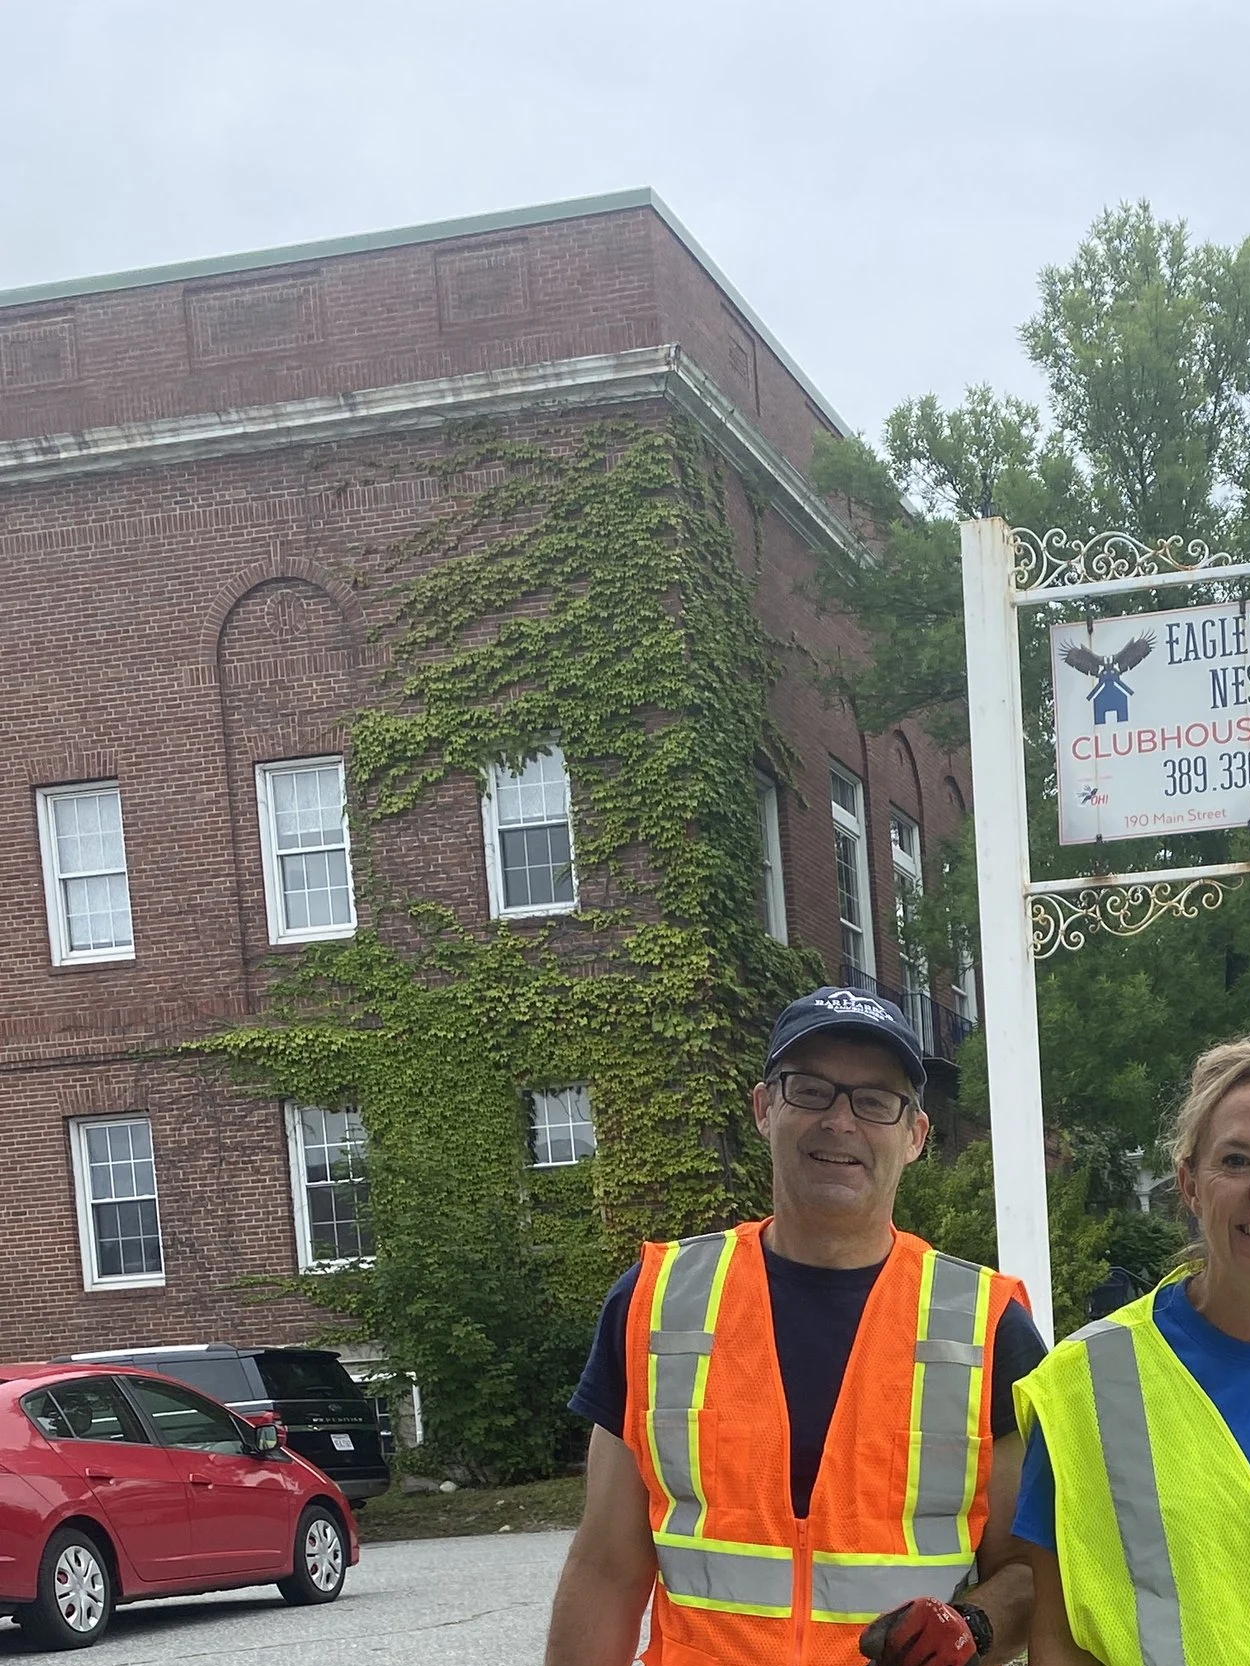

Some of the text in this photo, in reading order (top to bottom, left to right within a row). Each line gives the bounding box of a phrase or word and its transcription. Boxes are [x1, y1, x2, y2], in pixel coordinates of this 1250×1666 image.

[1124, 808, 1227, 829] 190 Main Street
